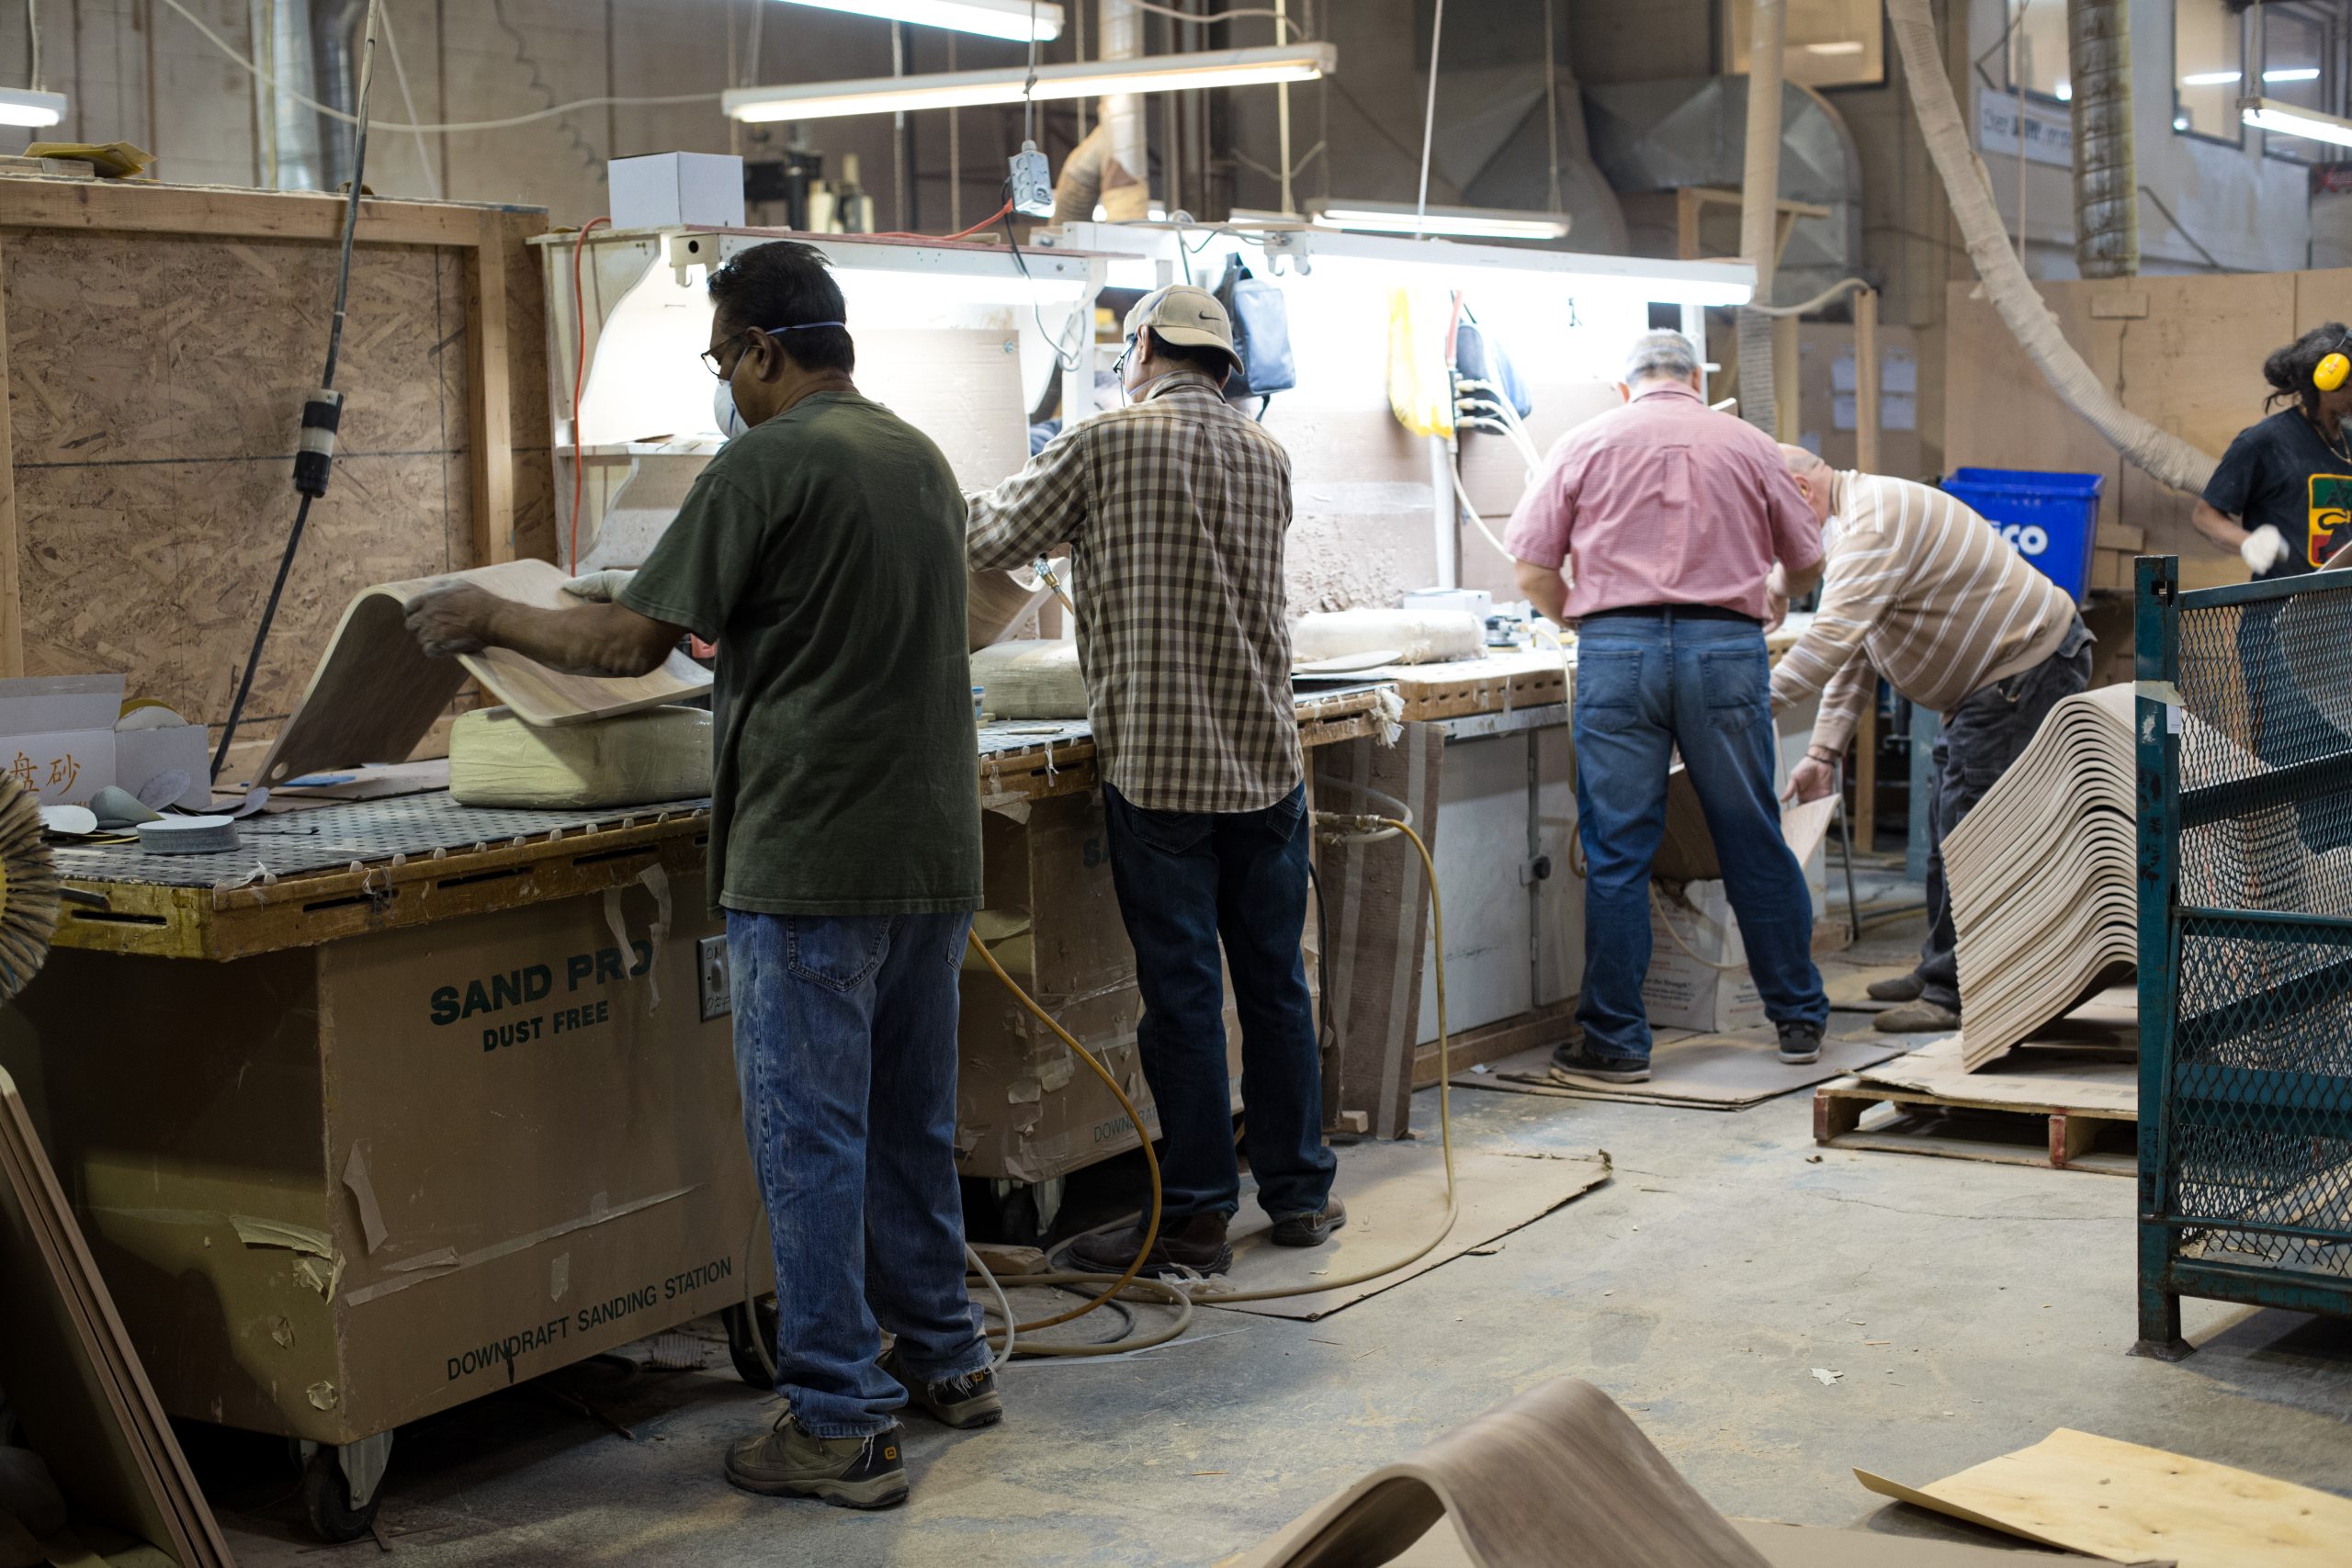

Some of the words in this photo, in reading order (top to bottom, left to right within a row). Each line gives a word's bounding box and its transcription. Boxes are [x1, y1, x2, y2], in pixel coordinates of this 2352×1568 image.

[430, 964, 552, 1026] SAND
[568, 940, 652, 992] PRO
[483, 1017, 544, 1052] DUST
[553, 999, 609, 1035] FREE
[447, 1316, 570, 1381] DOWNDRAFT
[578, 1286, 657, 1332] SANDING
[664, 1256, 732, 1300] STATION
